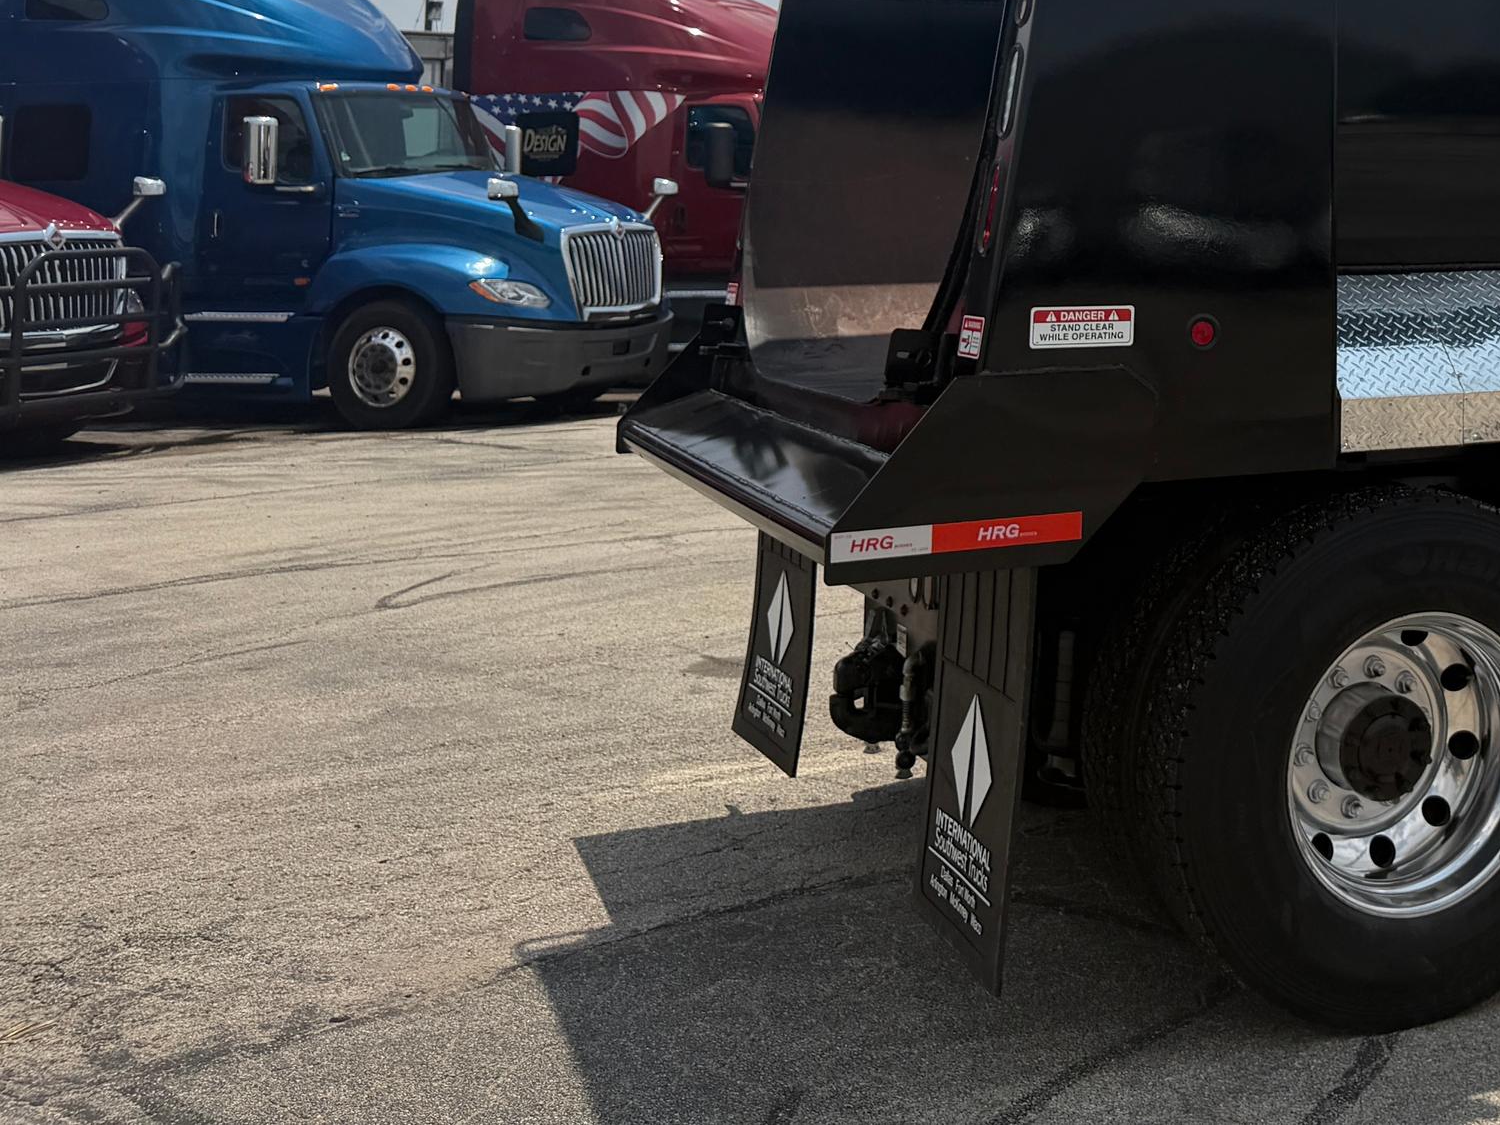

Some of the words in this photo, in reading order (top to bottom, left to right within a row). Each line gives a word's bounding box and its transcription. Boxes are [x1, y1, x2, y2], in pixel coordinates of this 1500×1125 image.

[1060, 311, 1105, 321] DANGER
[1039, 333, 1069, 341] WHILE
[1071, 331, 1124, 341] OPERATING
[1050, 323, 1081, 332] STAND
[1083, 322, 1114, 331] CLEAR
[977, 524, 1020, 542] HRG
[850, 535, 894, 553] HRG
[935, 807, 991, 873] INTERNATIONAL
[934, 826, 968, 873] Southwest
[967, 854, 989, 893] Trucks
